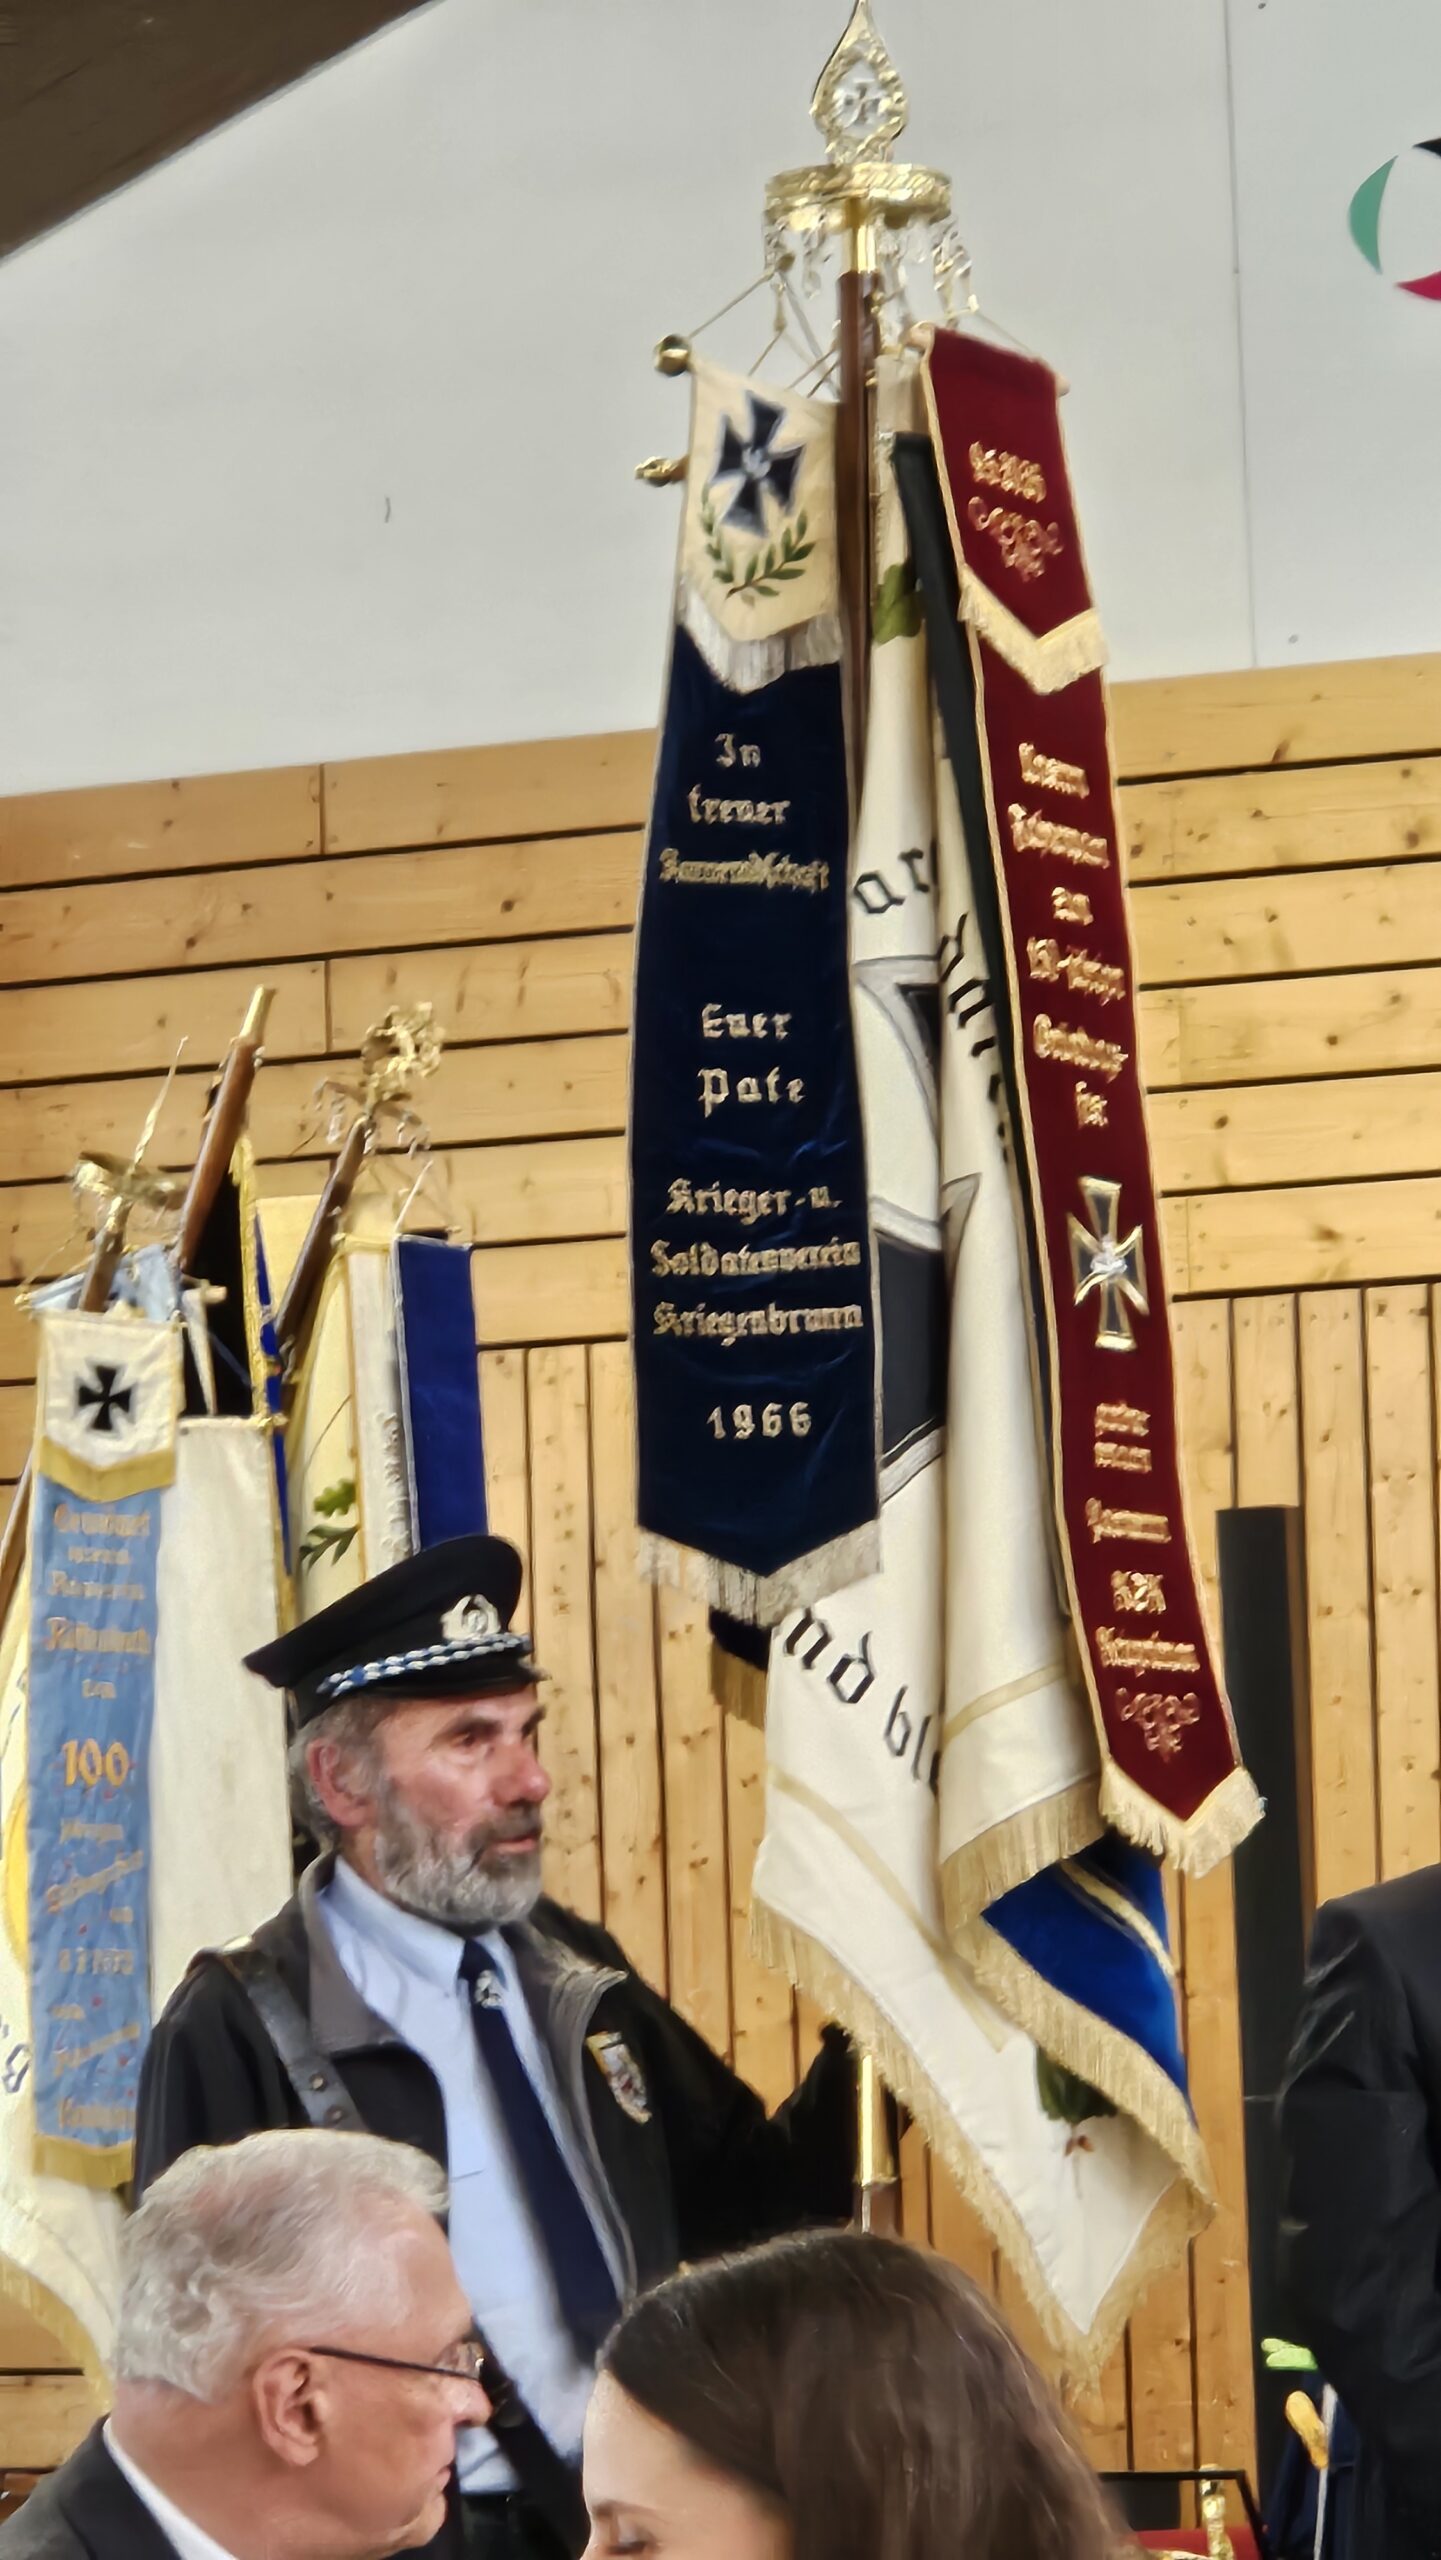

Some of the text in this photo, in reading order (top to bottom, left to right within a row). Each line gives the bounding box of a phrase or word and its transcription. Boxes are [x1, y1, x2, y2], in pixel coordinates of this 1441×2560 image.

[701, 1003, 792, 1040] Euer
[697, 1066, 806, 1118] Pate
[706, 1402, 812, 1440] 1966
[63, 1739, 129, 1788] 100
